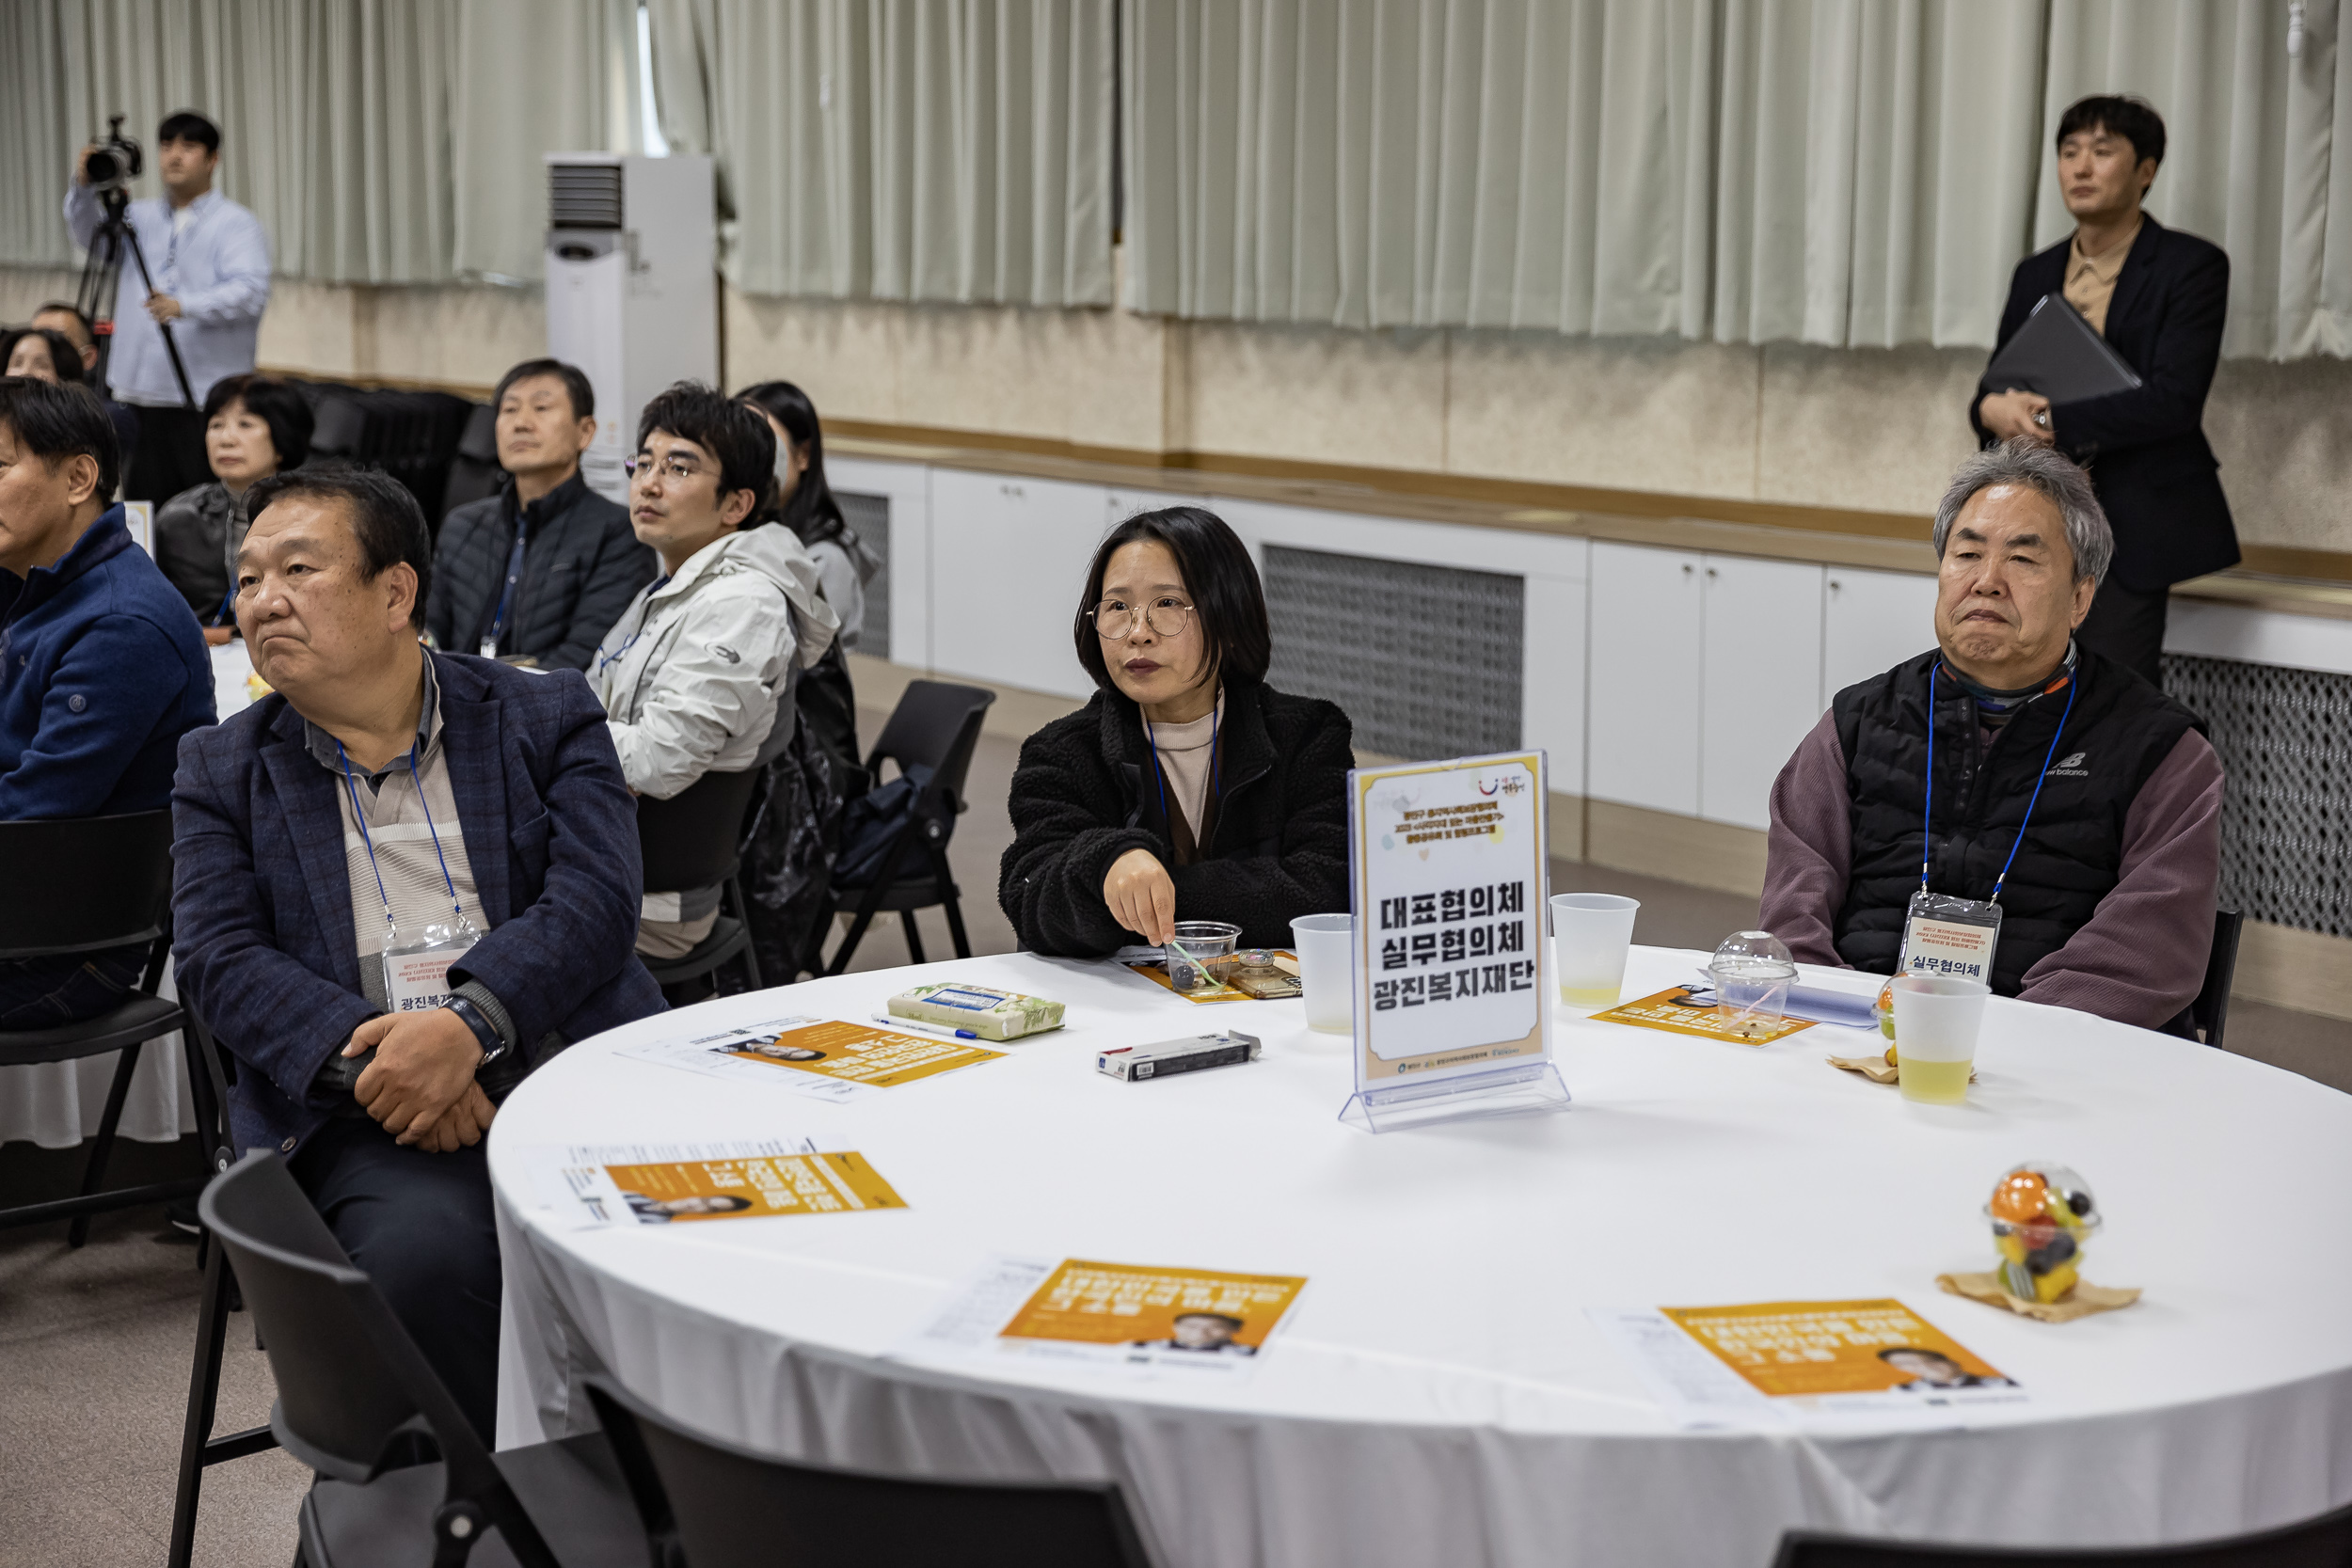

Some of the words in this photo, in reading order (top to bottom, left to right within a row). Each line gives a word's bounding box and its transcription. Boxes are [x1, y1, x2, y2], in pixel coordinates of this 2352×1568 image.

[1380, 880, 1524, 931] 대표협의체
[1381, 920, 1524, 971] 실무협의체
[1913, 956, 1981, 977] 실무협의체
[1374, 960, 1534, 1012] 광진복지재단
